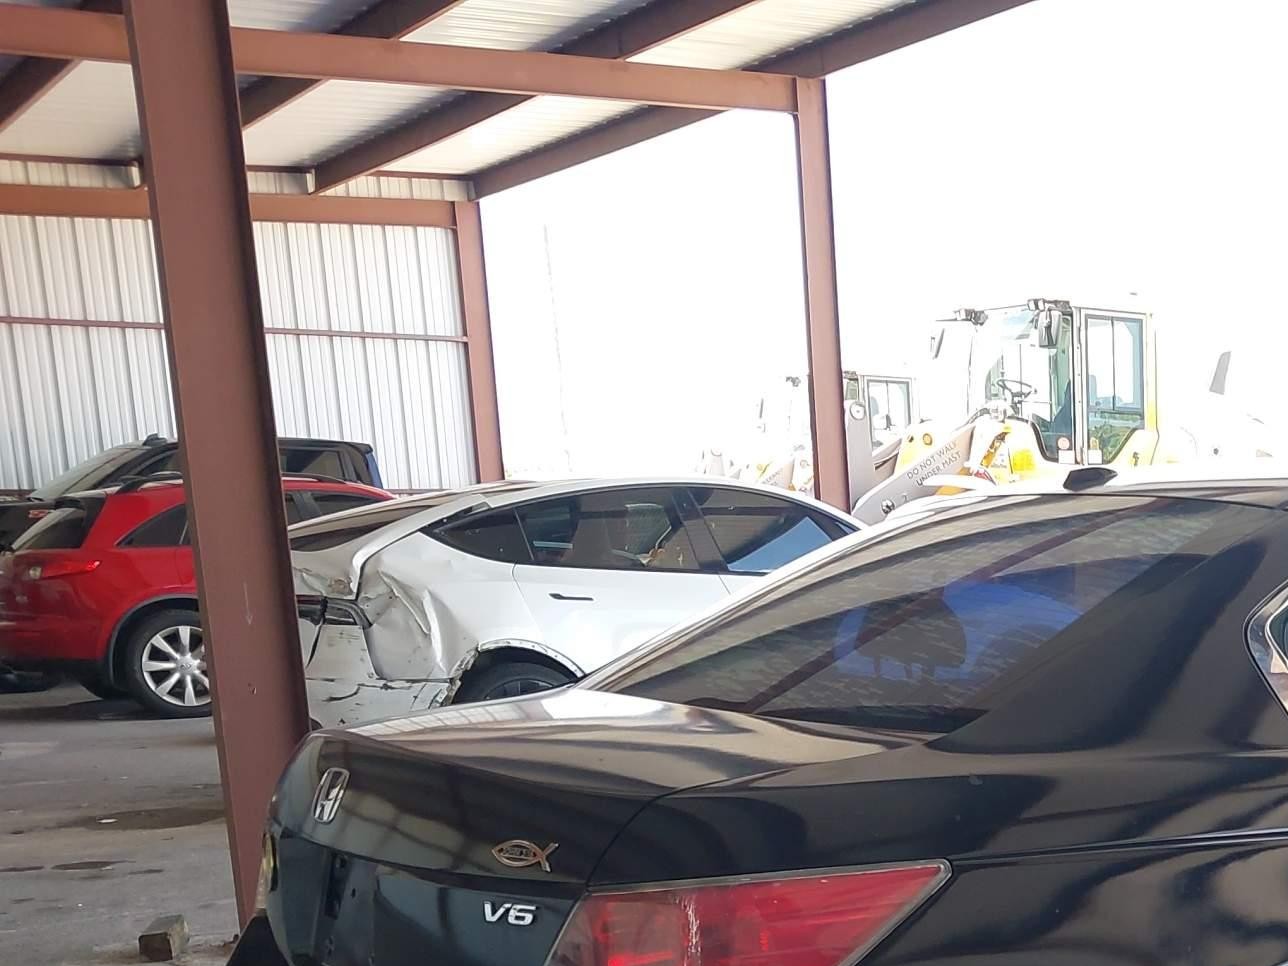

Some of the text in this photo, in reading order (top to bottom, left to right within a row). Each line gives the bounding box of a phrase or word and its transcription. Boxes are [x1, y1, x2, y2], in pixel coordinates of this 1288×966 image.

[906, 467, 919, 480] DO
[919, 455, 937, 471] NOT
[915, 450, 961, 486] UNDER MAST
[484, 901, 536, 925] V6
